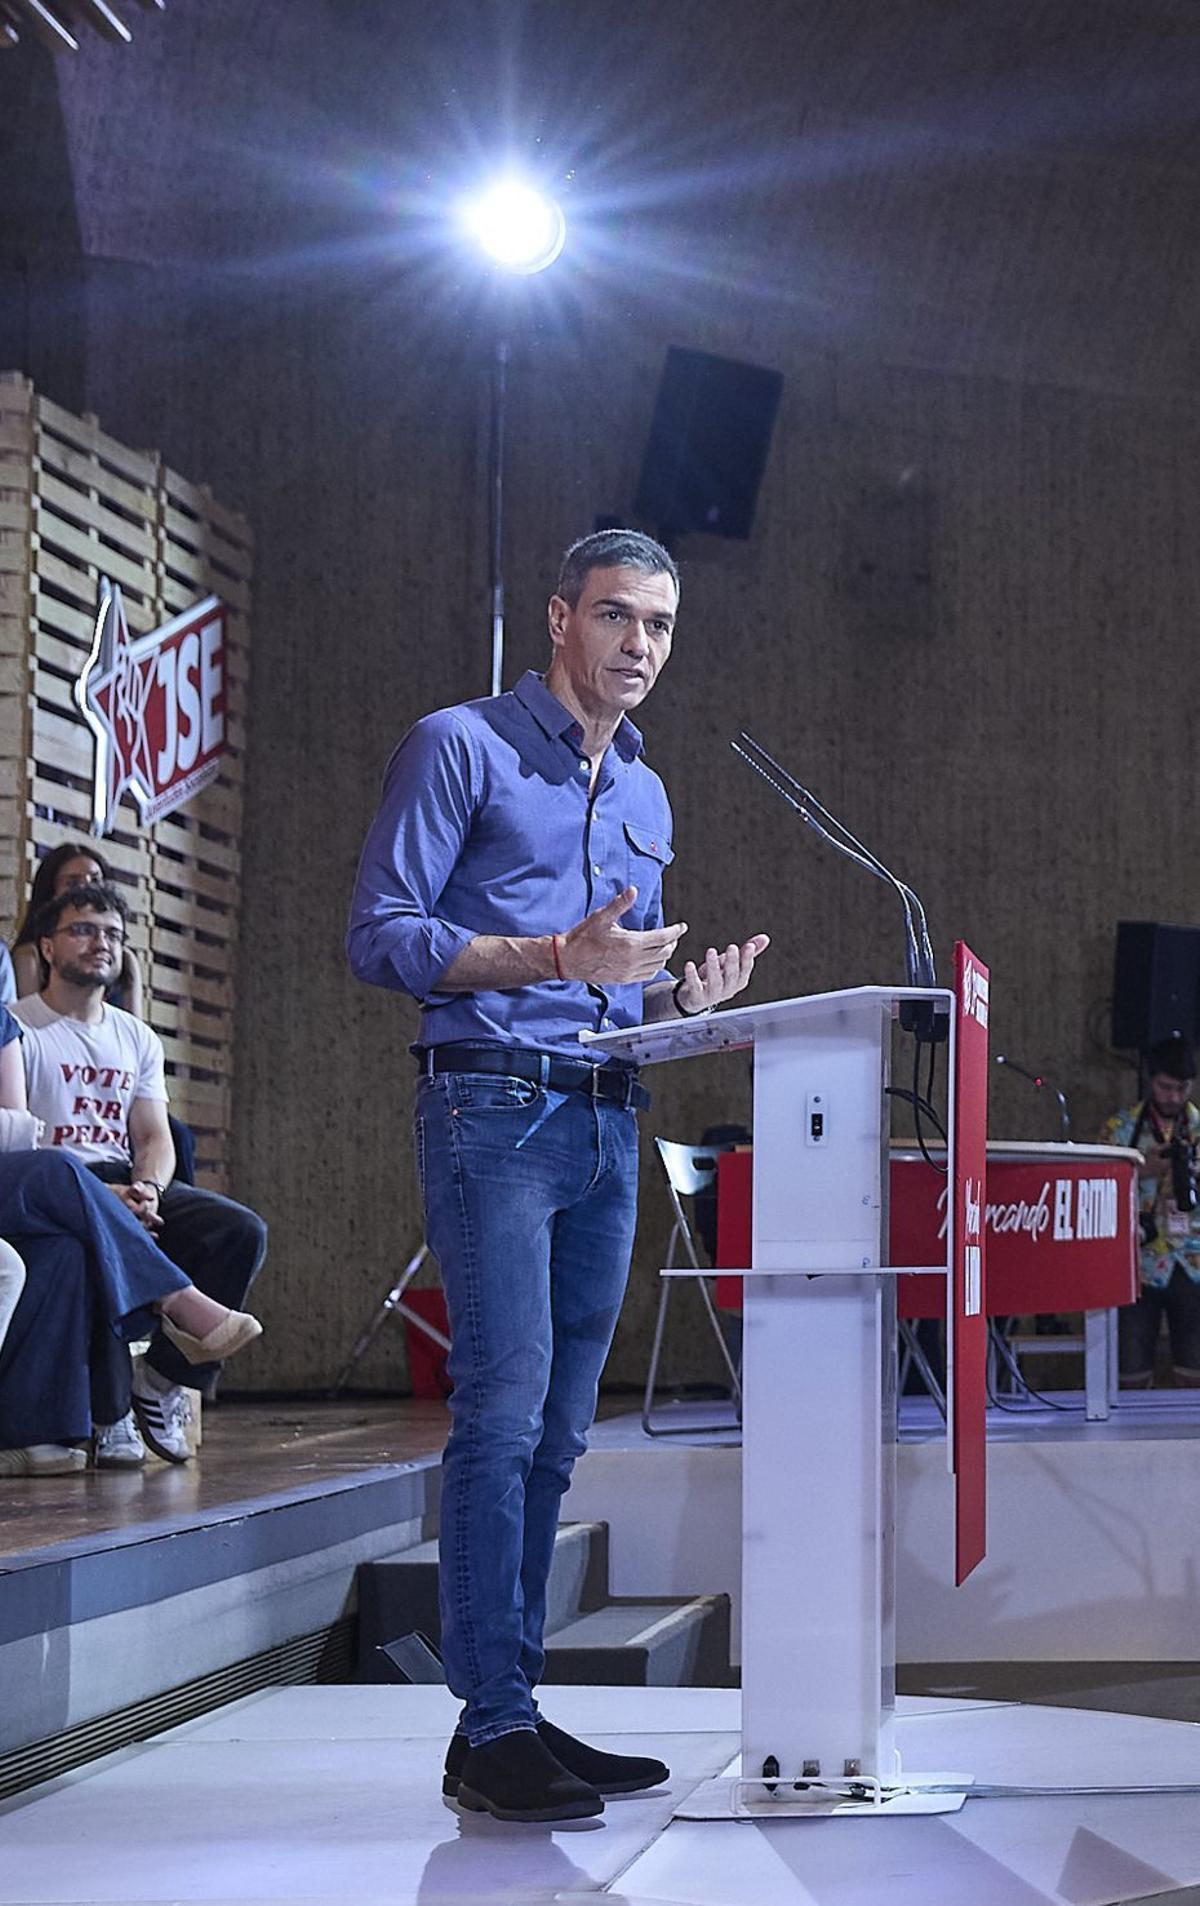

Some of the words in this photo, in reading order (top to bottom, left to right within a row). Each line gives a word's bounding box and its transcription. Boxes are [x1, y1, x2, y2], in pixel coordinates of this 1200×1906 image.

[157, 618, 223, 785] JSE
[60, 1064, 134, 1091] VOTE
[937, 1181, 1050, 1242] rcando
[1053, 1179, 1074, 1240] EL
